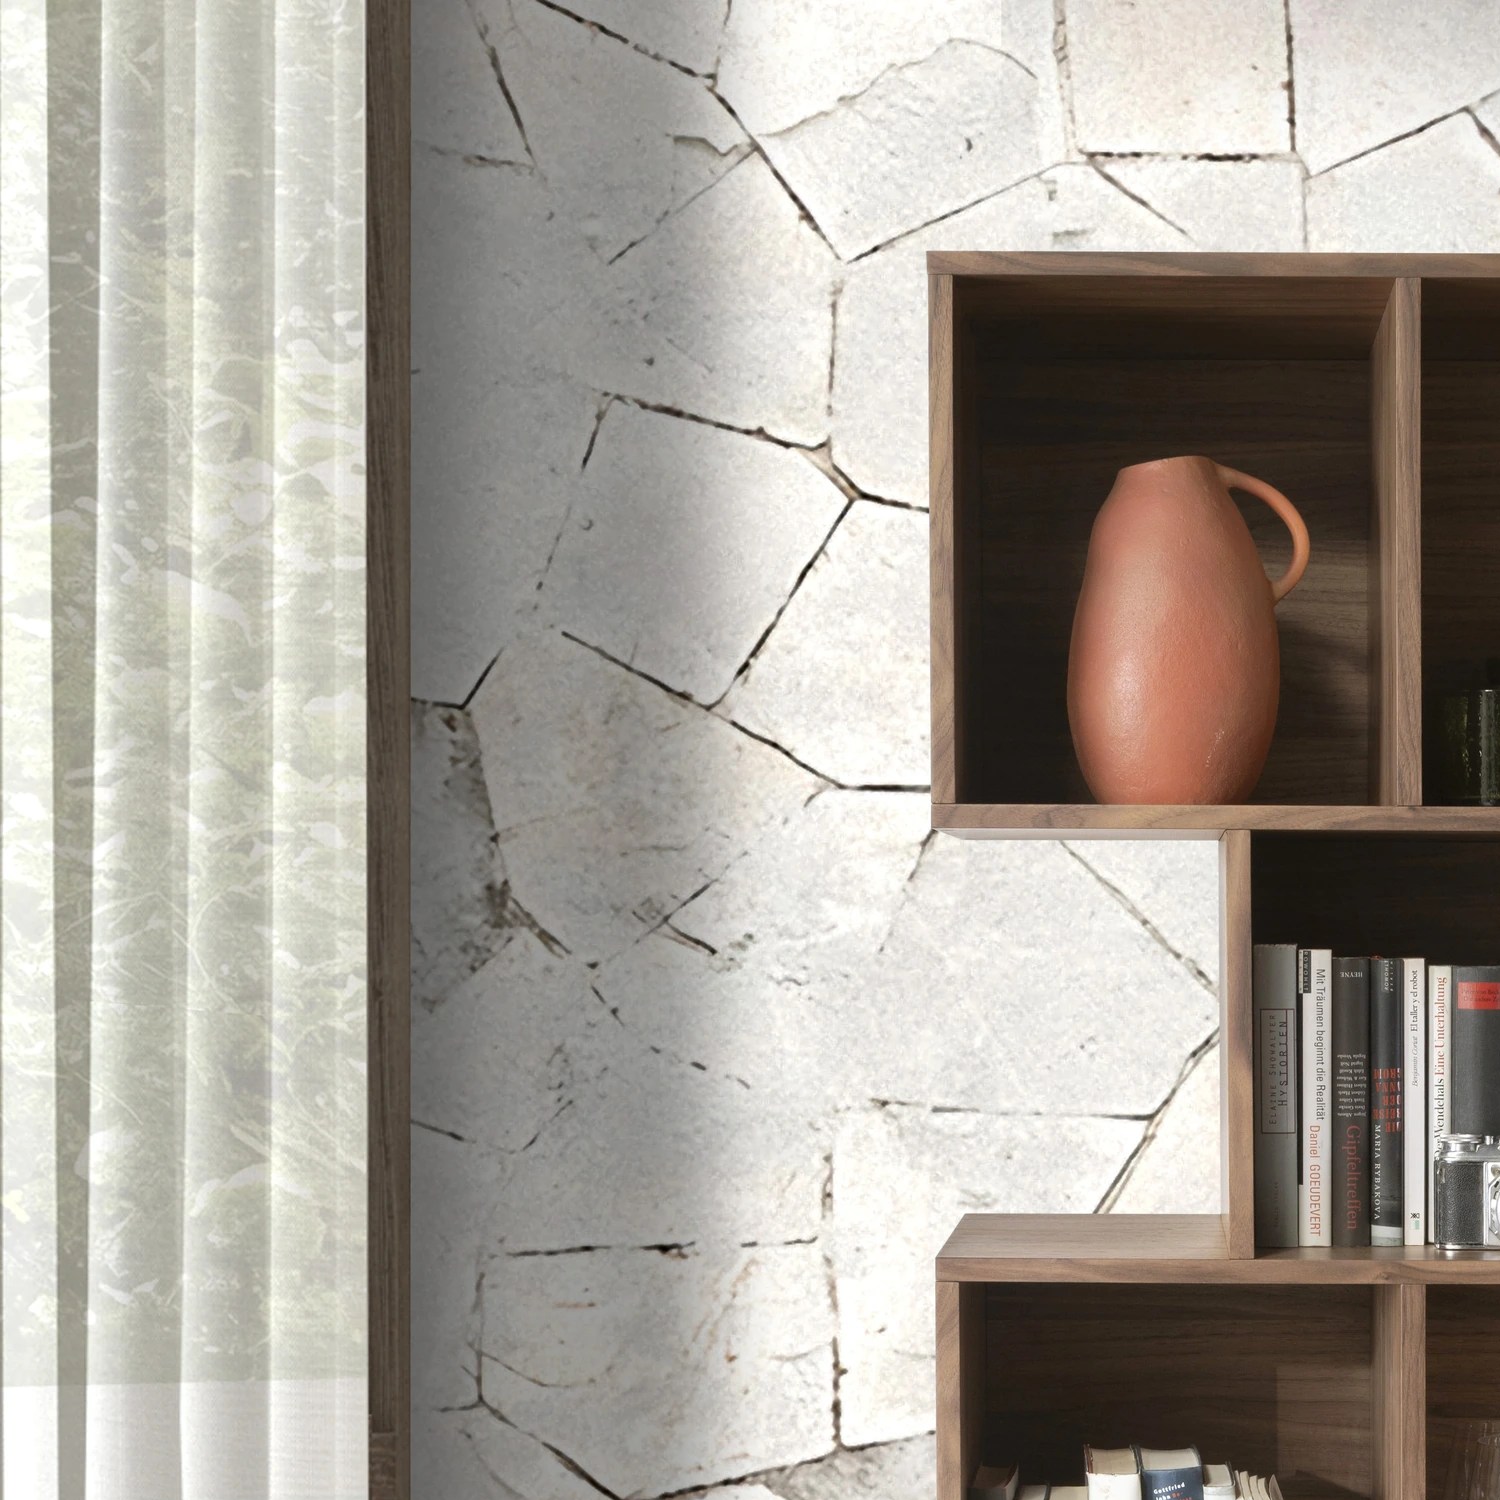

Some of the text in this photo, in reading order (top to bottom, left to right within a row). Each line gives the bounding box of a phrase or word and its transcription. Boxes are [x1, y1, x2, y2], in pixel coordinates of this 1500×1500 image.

[1410, 969, 1418, 990] robot
[1410, 1003, 1418, 1022] taller
[1435, 976, 1449, 1048] Unterhaltung
[1410, 1023, 1418, 1031] El
[1314, 969, 1326, 1120] Mit Träumen beginnt die Realität
[1268, 1014, 1276, 1124] ELAINE SHOWALTER
[1277, 1021, 1287, 1106] HYSTORIEN
[1373, 1068, 1401, 1079] GROM
[1435, 1050, 1446, 1075] Eine
[1375, 1082, 1401, 1093] ANNA
[1382, 1095, 1401, 1106] DER
[1434, 1078, 1444, 1138] Wendehals
[1309, 1125, 1321, 1237] Daniel GOEUDEVERT
[1342, 1125, 1362, 1230] Gipfeltreffen
[1153, 1482, 1185, 1495] Gottfried
